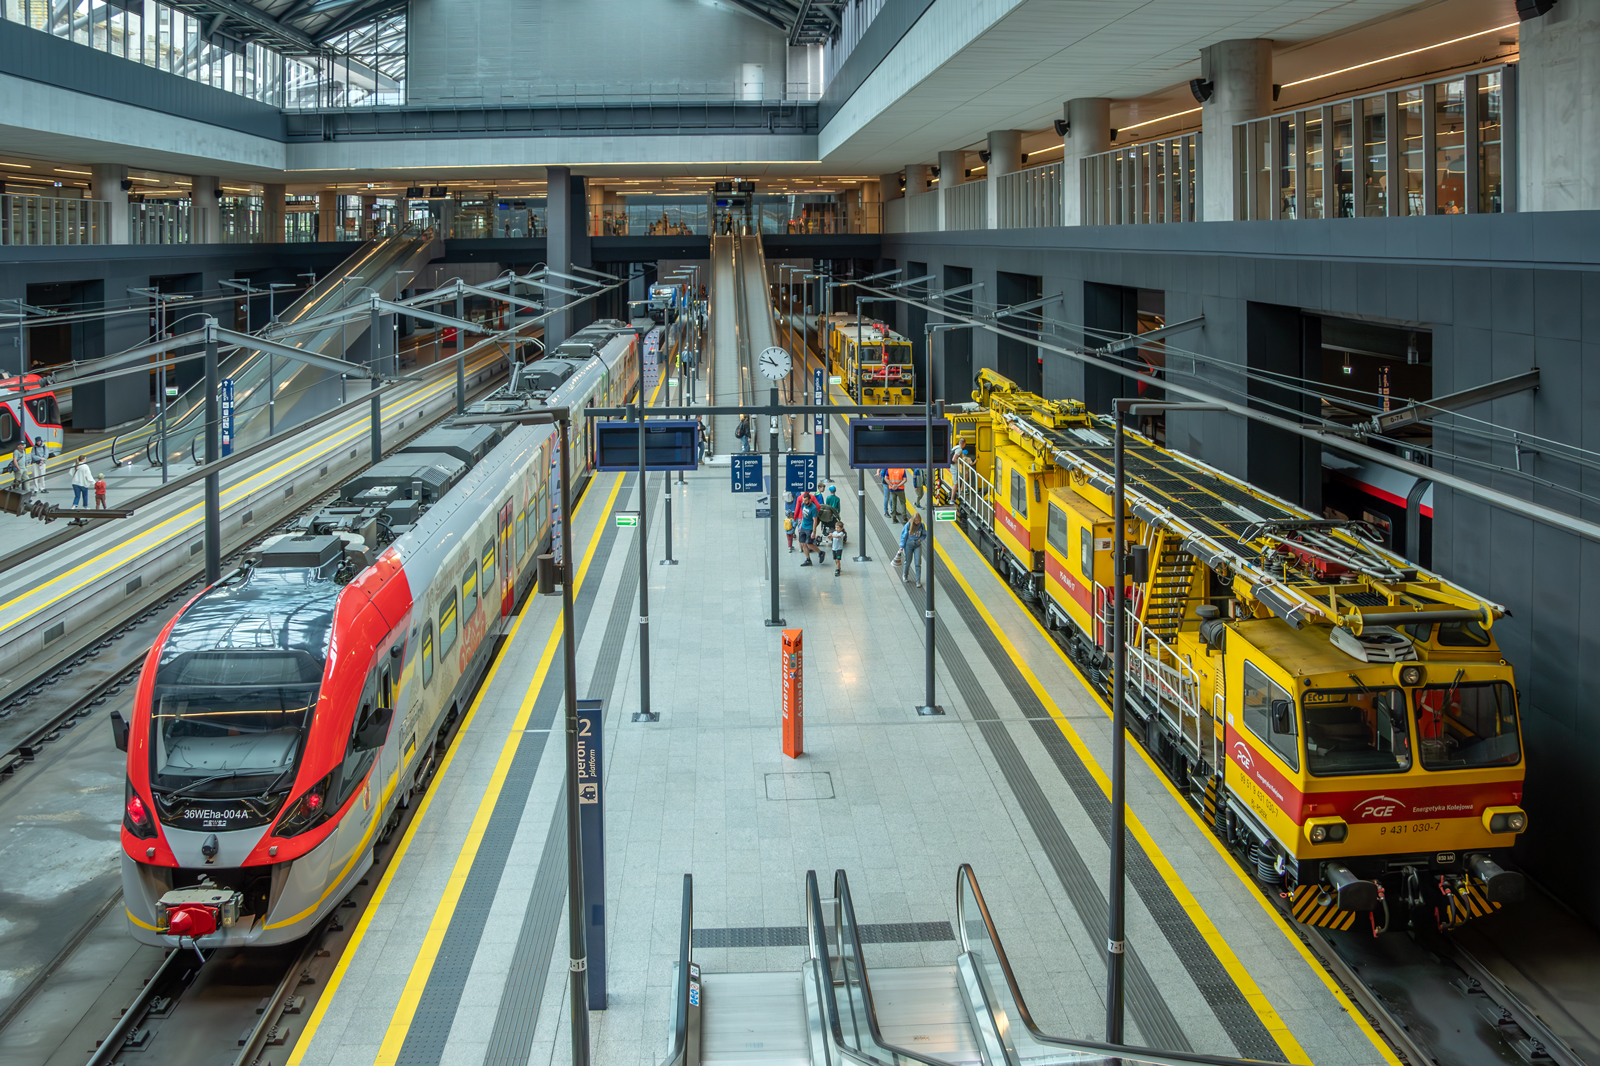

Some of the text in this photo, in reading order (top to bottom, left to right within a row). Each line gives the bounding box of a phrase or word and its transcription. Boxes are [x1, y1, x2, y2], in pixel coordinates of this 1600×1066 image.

[734, 460, 740, 468] 2
[808, 459, 814, 467] 2
[578, 718, 591, 778] peron 2
[589, 749, 597, 777] platform
[184, 810, 248, 818] 36WEha-004A
[1362, 806, 1395, 818] PGE
[1380, 823, 1440, 835] 9 431 030-7
